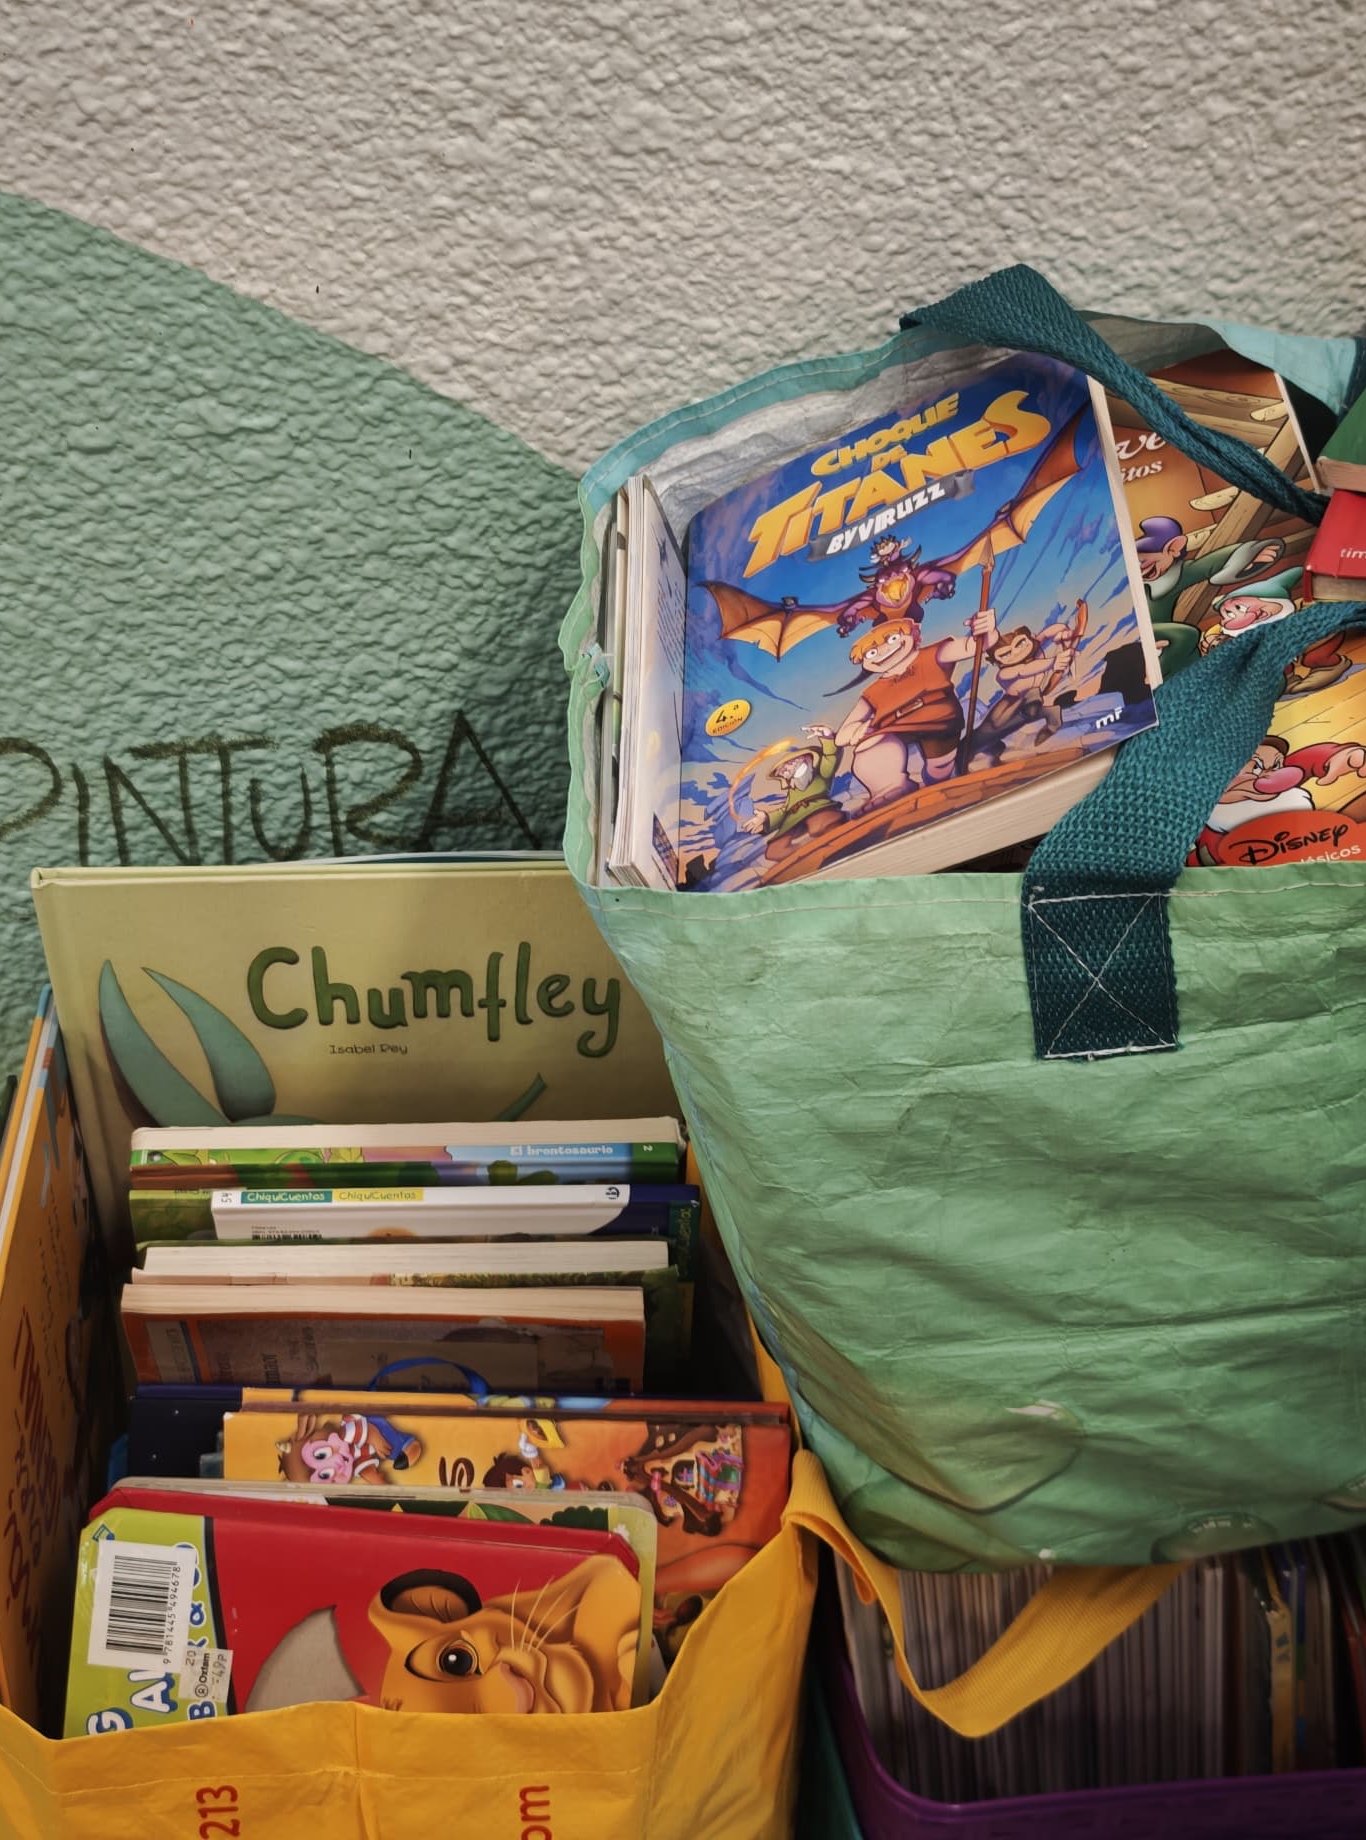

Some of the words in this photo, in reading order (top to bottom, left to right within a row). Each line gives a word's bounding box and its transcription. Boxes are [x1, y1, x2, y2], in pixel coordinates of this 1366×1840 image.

[810, 391, 960, 476] CHOQUE
[871, 444, 908, 473] DE
[742, 389, 1052, 579] TITANES
[246, 941, 622, 1059] Chumfley
[198, 1652, 211, 1683] Oxfam
